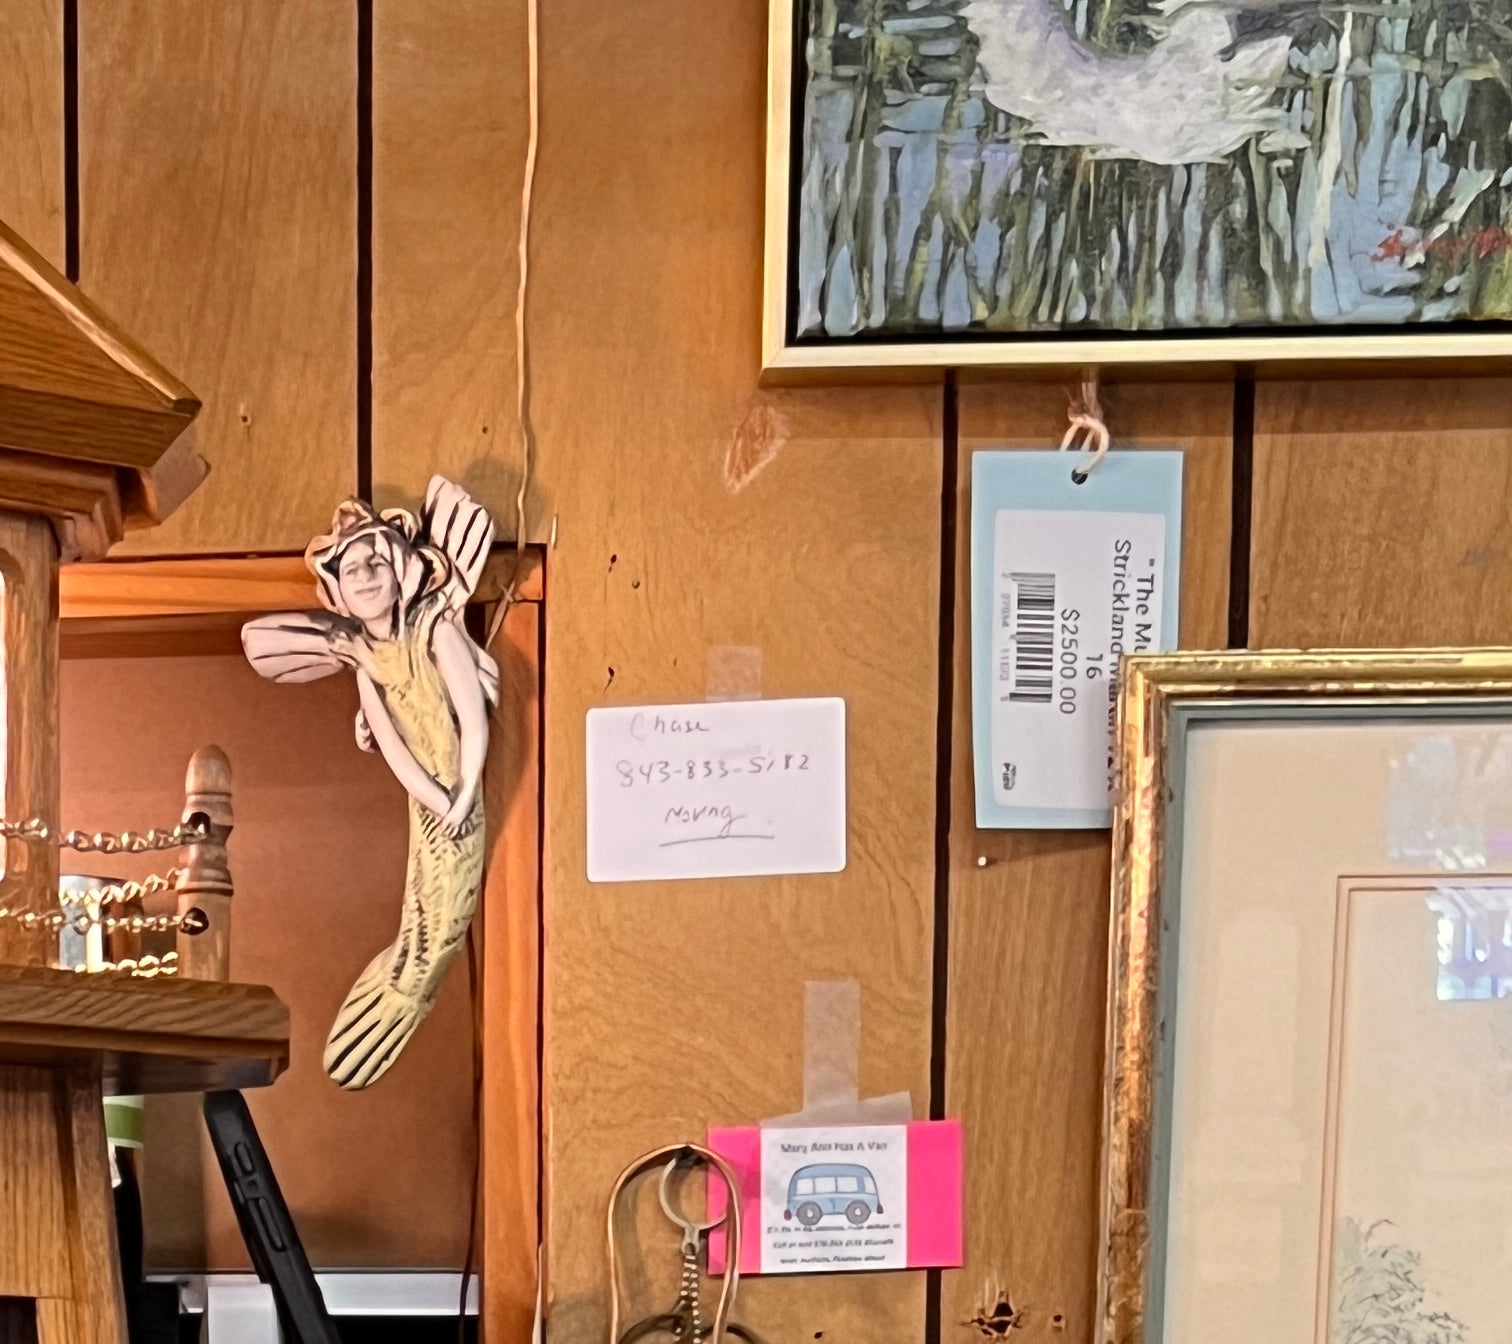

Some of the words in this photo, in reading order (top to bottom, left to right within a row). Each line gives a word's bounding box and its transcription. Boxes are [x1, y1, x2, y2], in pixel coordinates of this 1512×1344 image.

[1110, 538, 1133, 653] Strickland
[1136, 574, 1155, 617] The
[1059, 608, 1081, 715] $2500.00
[1085, 653, 1104, 680] 16
